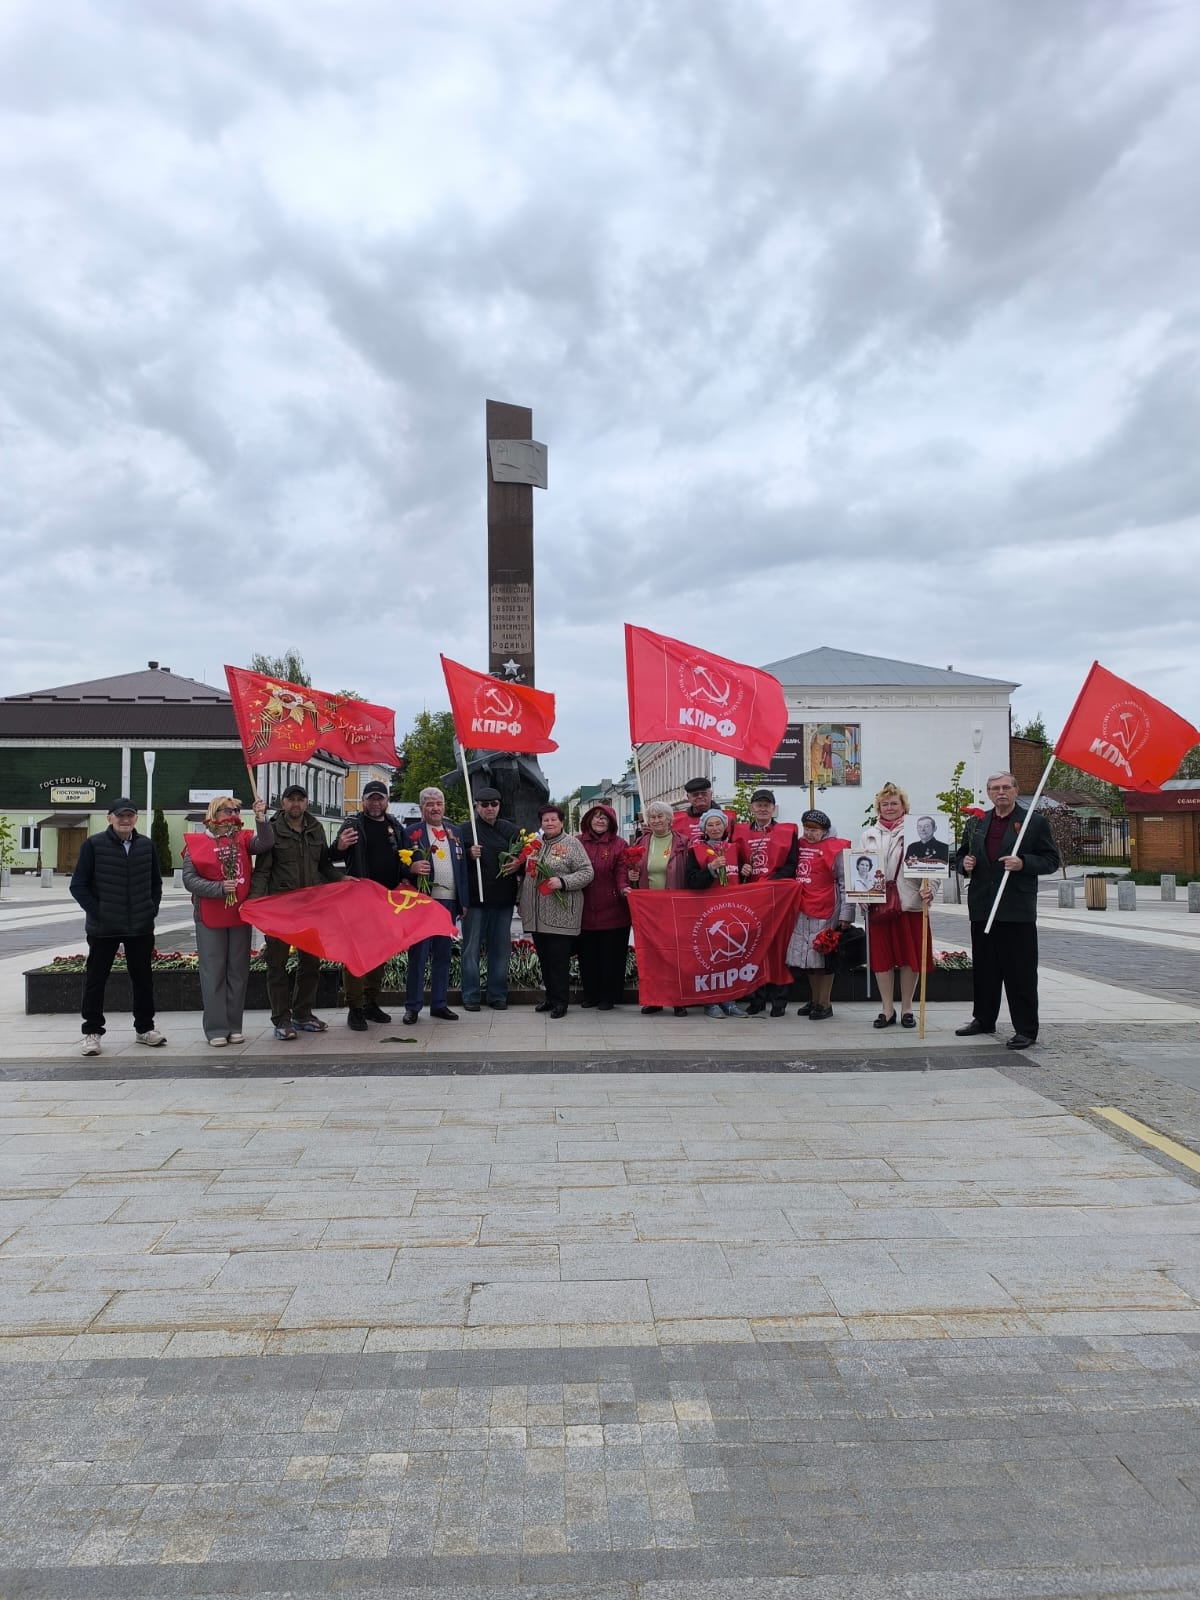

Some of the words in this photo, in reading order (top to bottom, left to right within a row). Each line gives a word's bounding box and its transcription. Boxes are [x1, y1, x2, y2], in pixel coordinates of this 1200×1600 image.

[471, 717, 522, 737] КПРФ
[679, 707, 737, 737] КПРФ
[39, 776, 83, 790] ГОСТЕВОЙ
[88, 779, 107, 790] ДОМ
[694, 963, 759, 993] КПРФ
